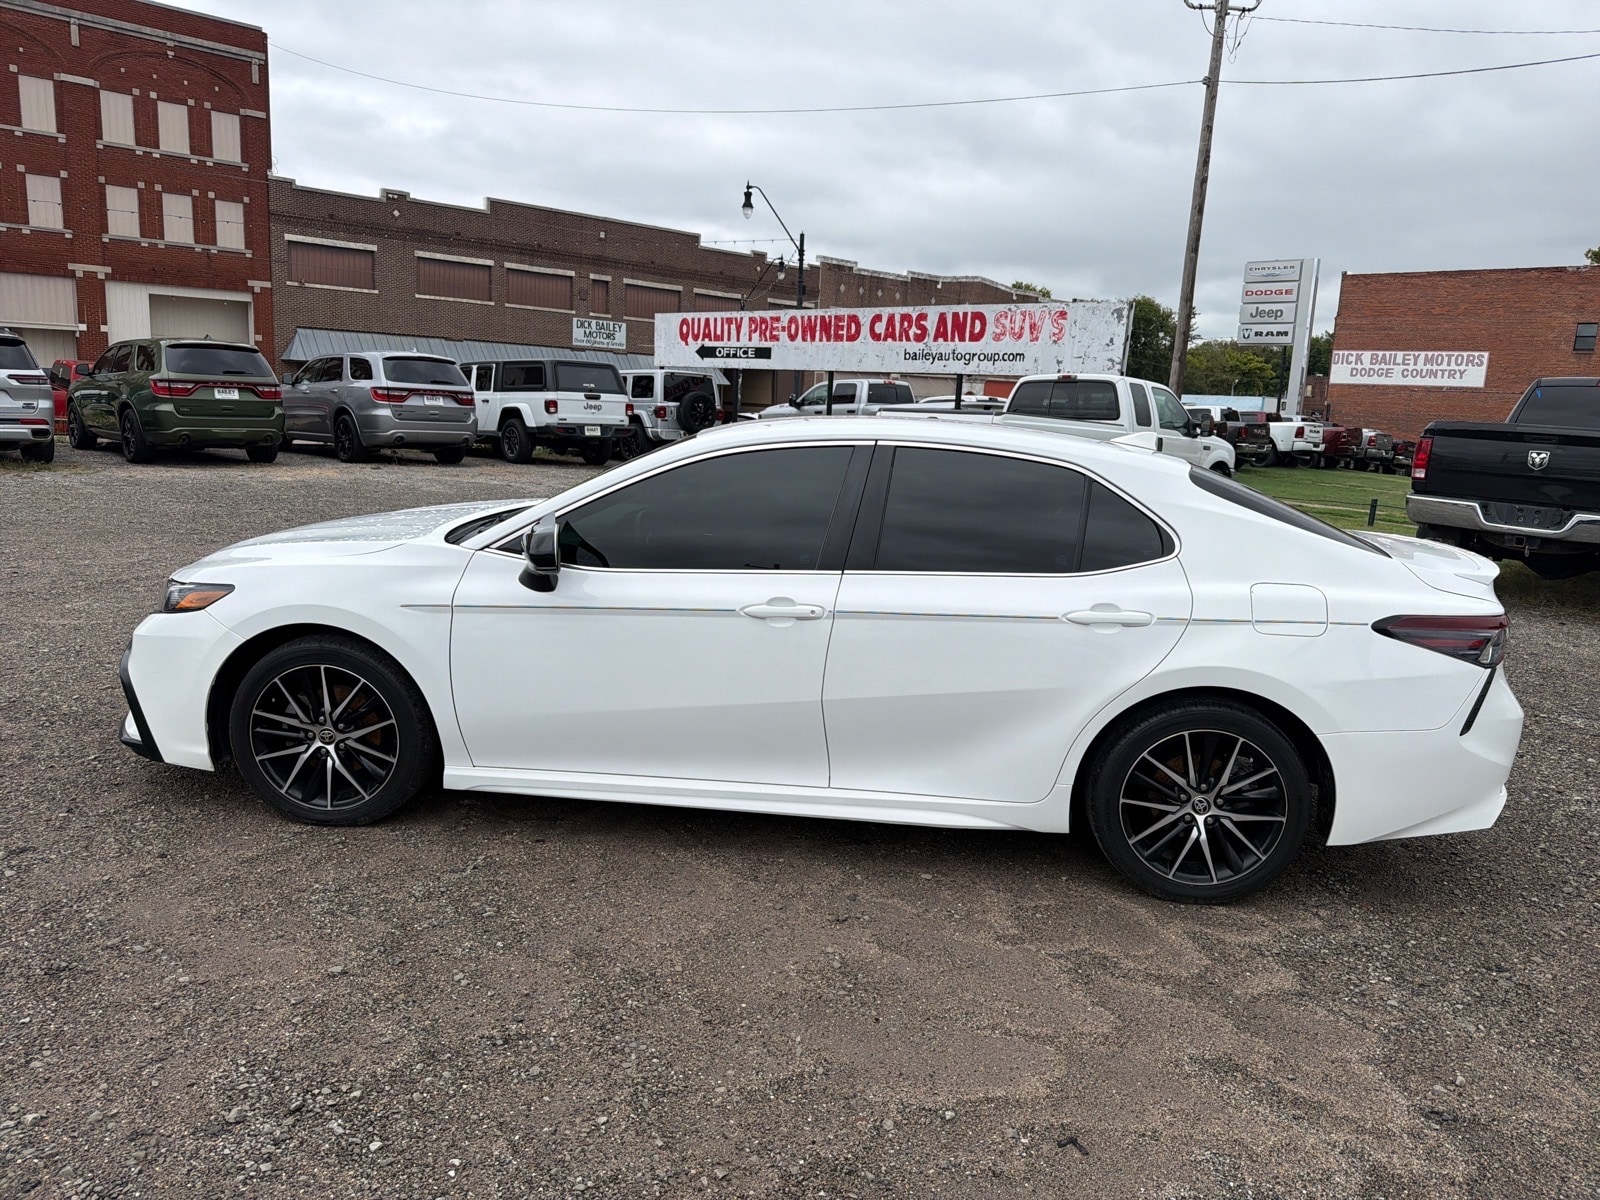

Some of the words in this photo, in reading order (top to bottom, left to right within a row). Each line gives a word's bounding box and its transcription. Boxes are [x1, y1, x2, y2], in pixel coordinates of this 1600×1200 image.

[1245, 289, 1293, 297] DODGE
[1249, 306, 1284, 320] Jeep
[576, 319, 593, 330] DICK
[595, 320, 623, 333] BAILEY
[679, 316, 743, 346] QUALITY
[748, 313, 862, 343] PRE-OWNED
[869, 312, 929, 343] CARS
[932, 311, 988, 342] AND
[992, 308, 1069, 343] SUV'S
[584, 330, 616, 341] MOTORS
[716, 347, 756, 358] OFFICE
[904, 349, 1026, 366] baileyautogroup.com
[1332, 352, 1364, 365] DICK
[1369, 353, 1422, 367] BAILEY
[1423, 354, 1485, 368] MOTORS
[1350, 367, 1395, 378] DODGE
[1401, 368, 1468, 380] COUNTRY
[583, 402, 602, 412] Jeep
